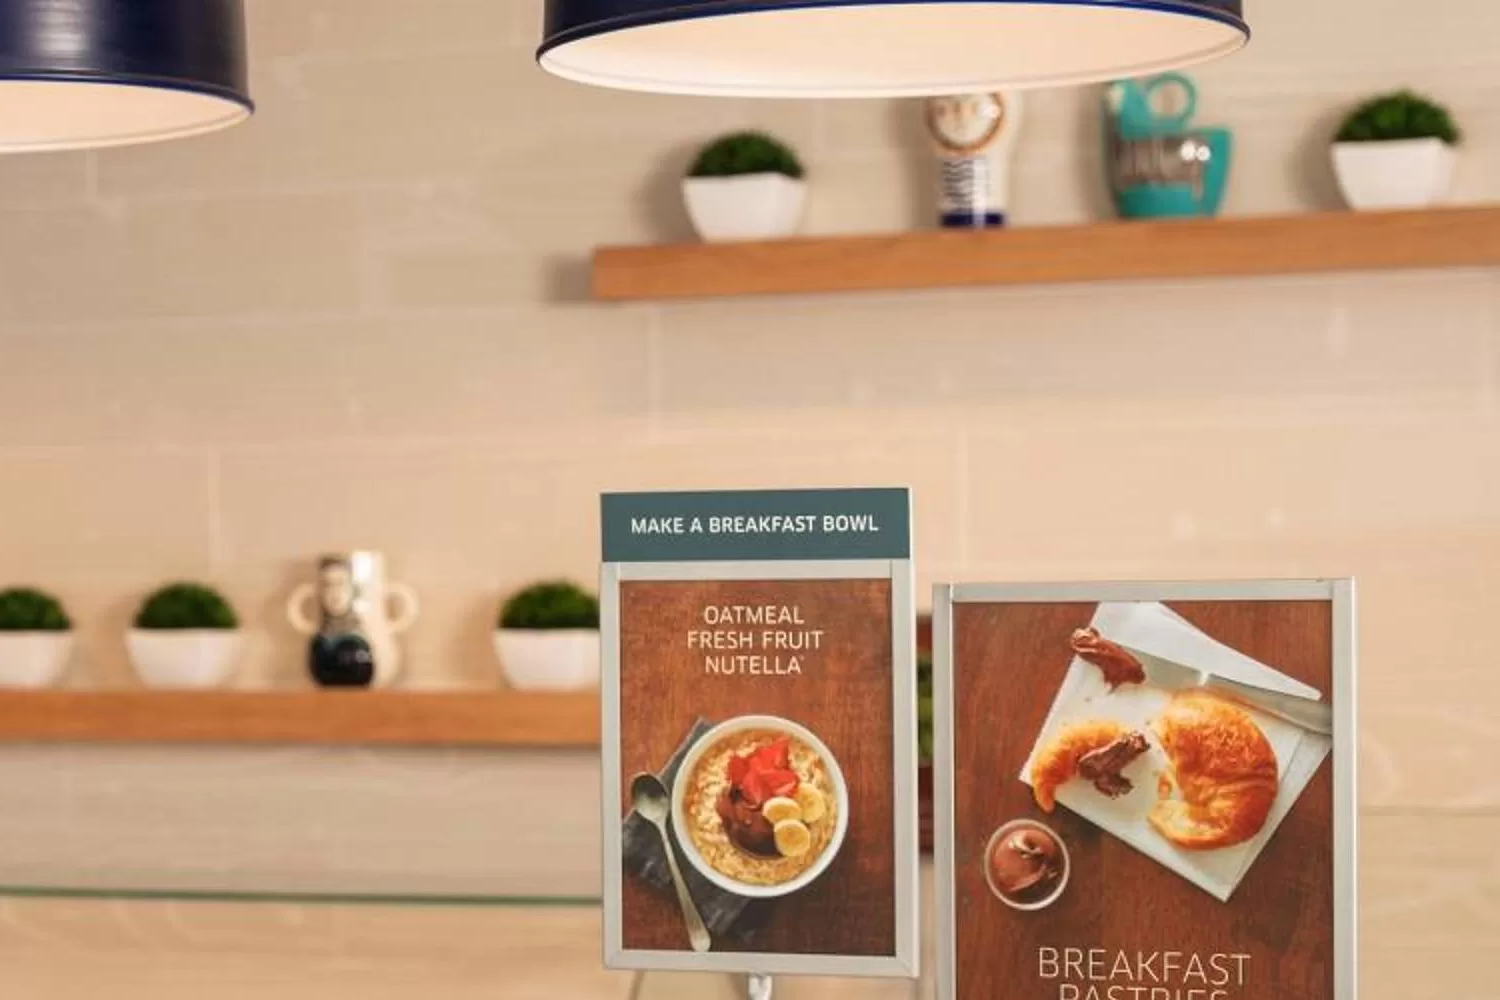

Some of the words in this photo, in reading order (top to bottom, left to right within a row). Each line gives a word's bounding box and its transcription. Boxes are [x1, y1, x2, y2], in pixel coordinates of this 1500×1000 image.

[631, 517, 684, 534] MAKE
[690, 517, 703, 533] A
[709, 515, 816, 533] BREAKFAST
[823, 515, 879, 531] BOWL
[704, 605, 804, 625] OATMEAL
[687, 630, 753, 650] FRESH
[762, 630, 825, 650] FRUIT
[1038, 946, 1252, 986] BREAKFAST
